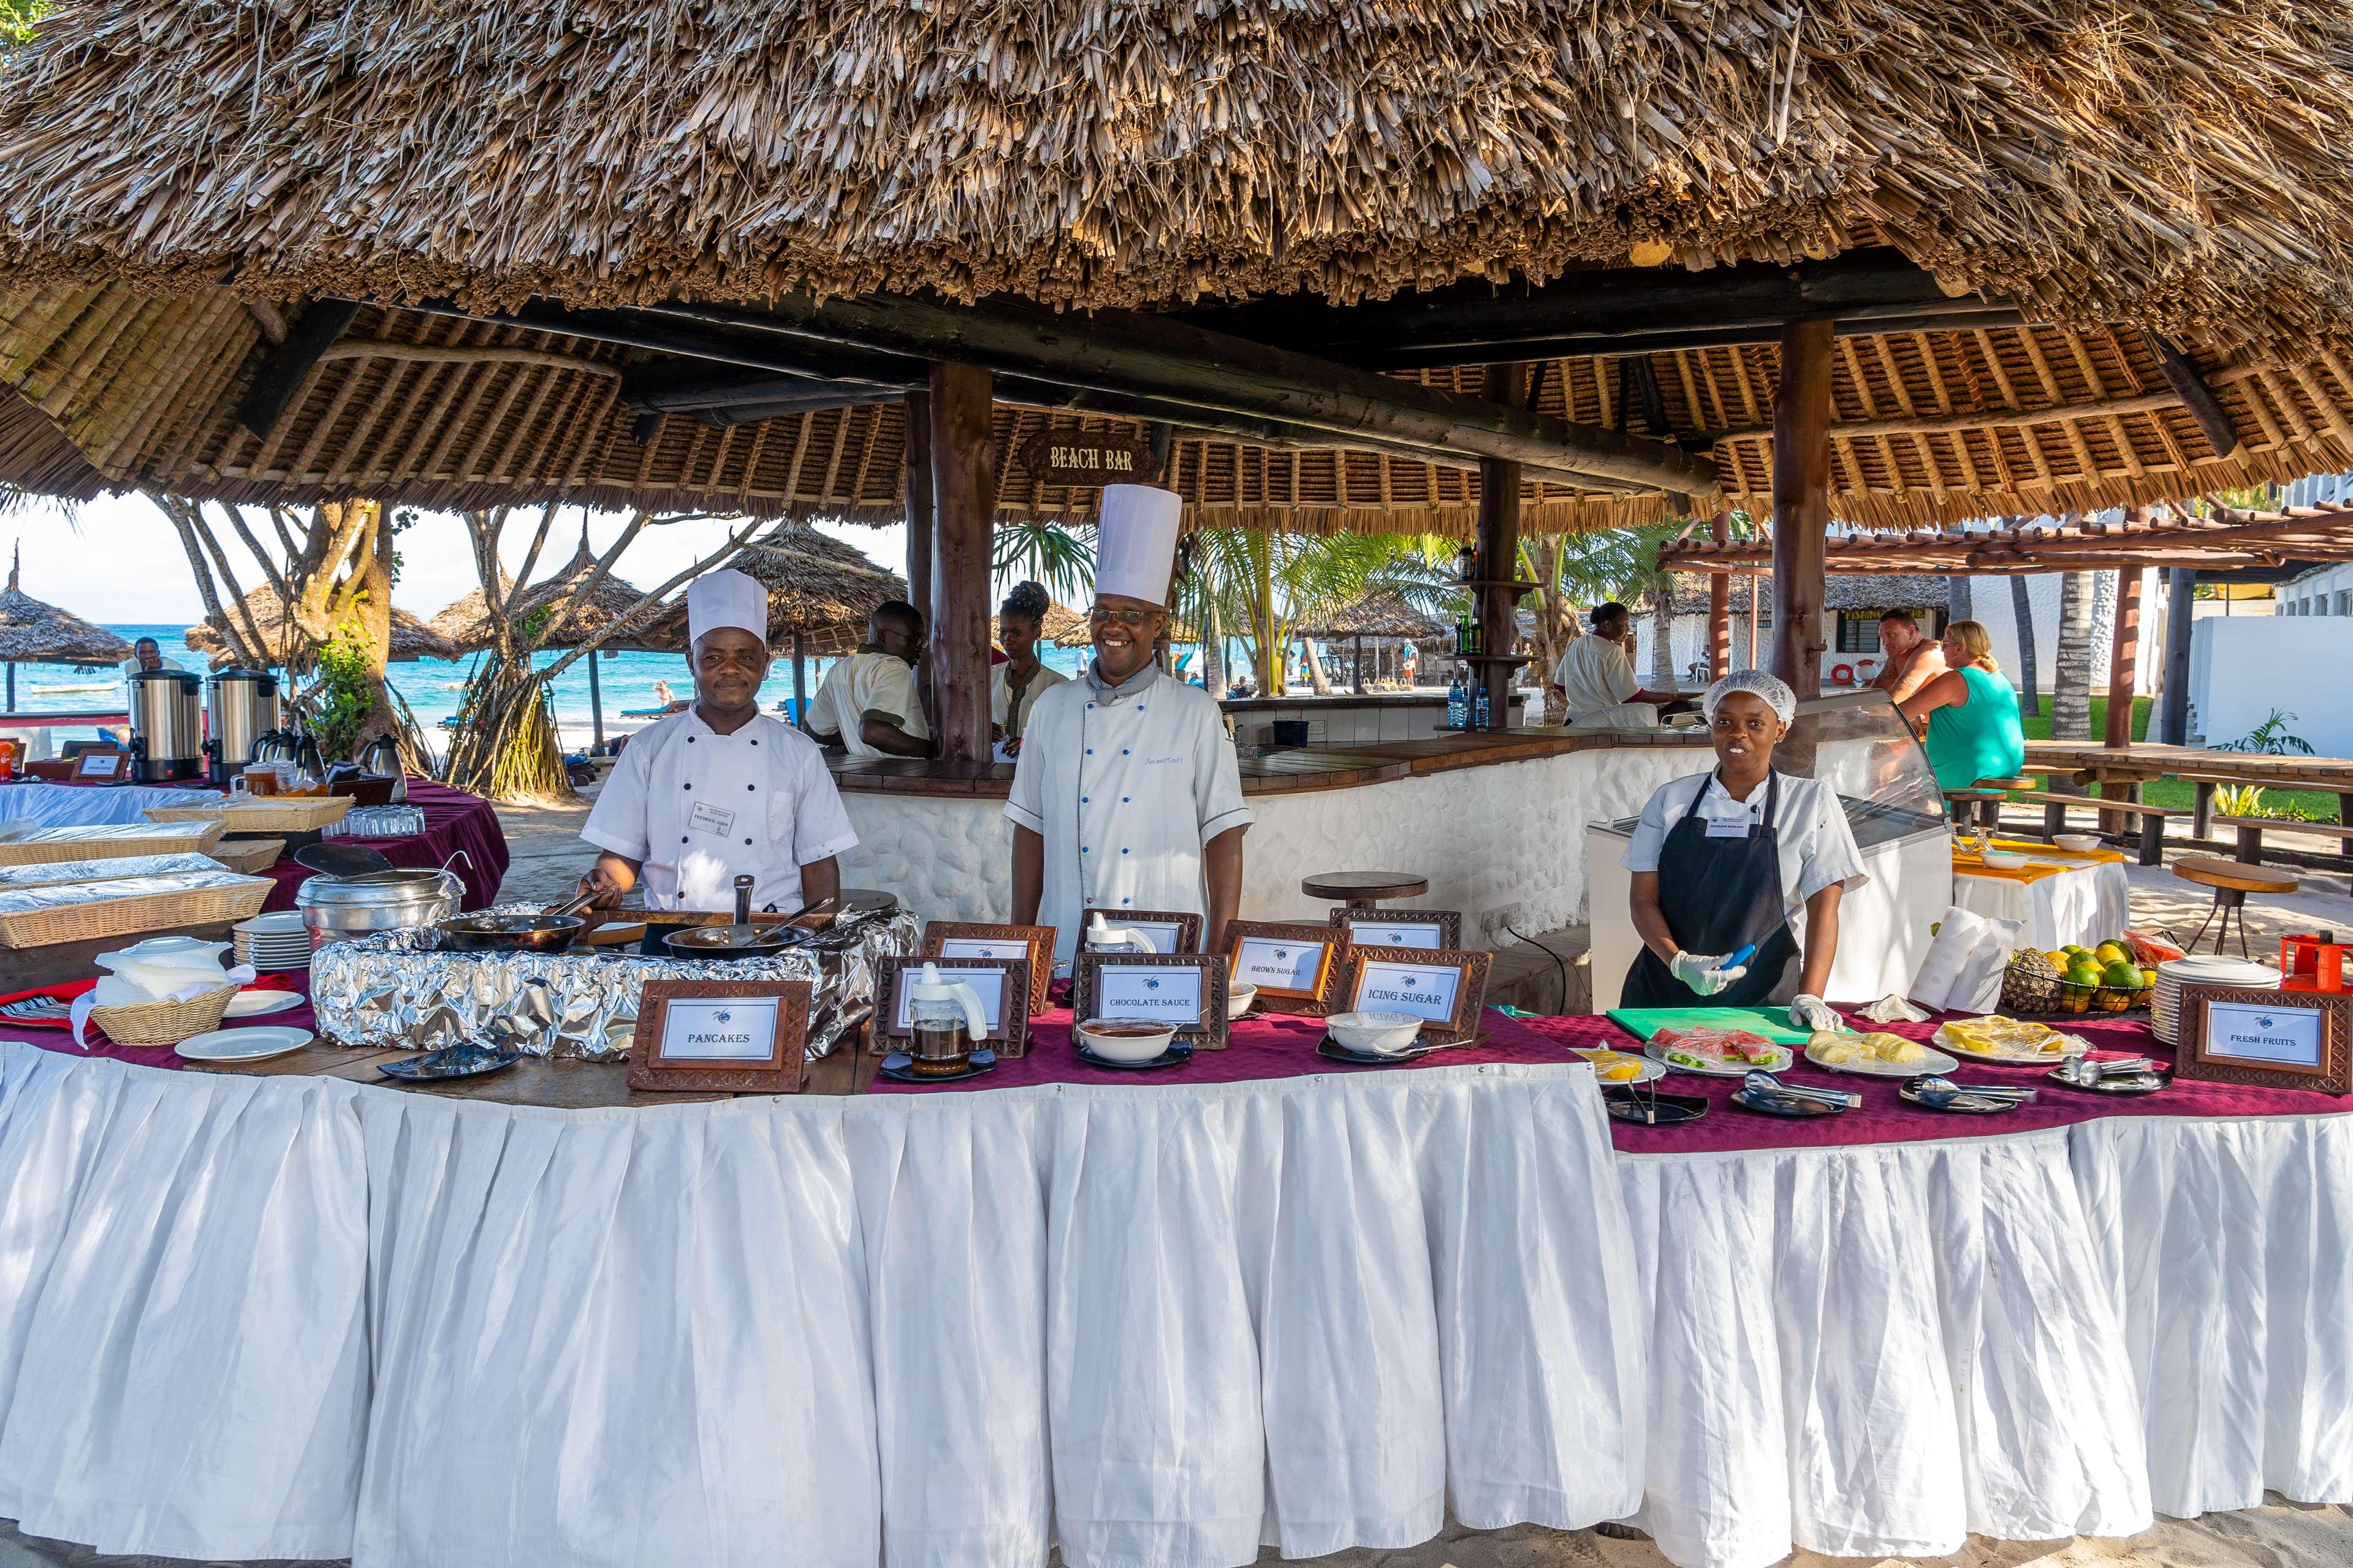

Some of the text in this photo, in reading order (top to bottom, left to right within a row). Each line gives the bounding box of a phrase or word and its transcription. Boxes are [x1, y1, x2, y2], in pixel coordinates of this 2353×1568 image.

[1050, 447, 1133, 472] BEACH BAR
[1251, 965, 1301, 976] BROWN SUGAR
[1368, 989, 1442, 1005] ICING SUGAR
[688, 1034, 750, 1043] PANCAKES
[2230, 1034, 2296, 1047] FRESH FRUITS
